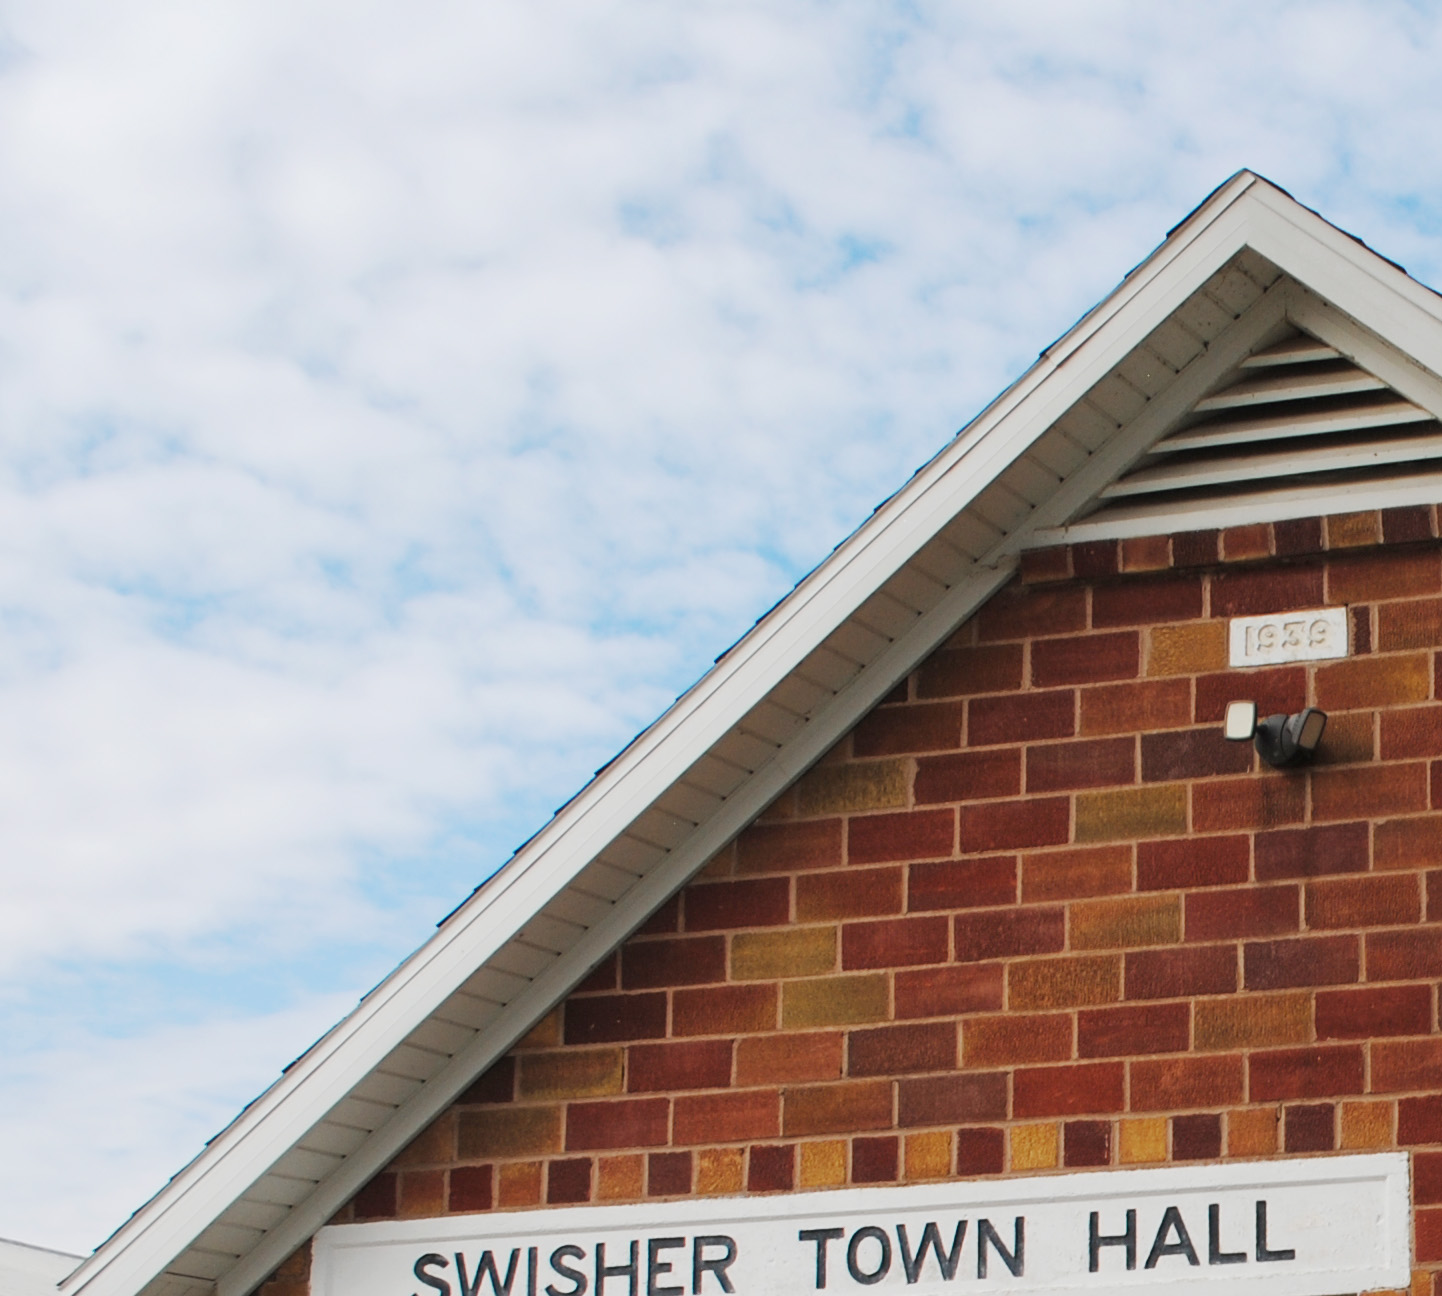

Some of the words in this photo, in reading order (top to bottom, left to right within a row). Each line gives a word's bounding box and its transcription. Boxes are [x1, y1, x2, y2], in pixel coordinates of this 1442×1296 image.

[1245, 618, 1332, 656] 1939
[799, 1216, 1026, 1289] TOWN
[1087, 1200, 1297, 1272] HALL
